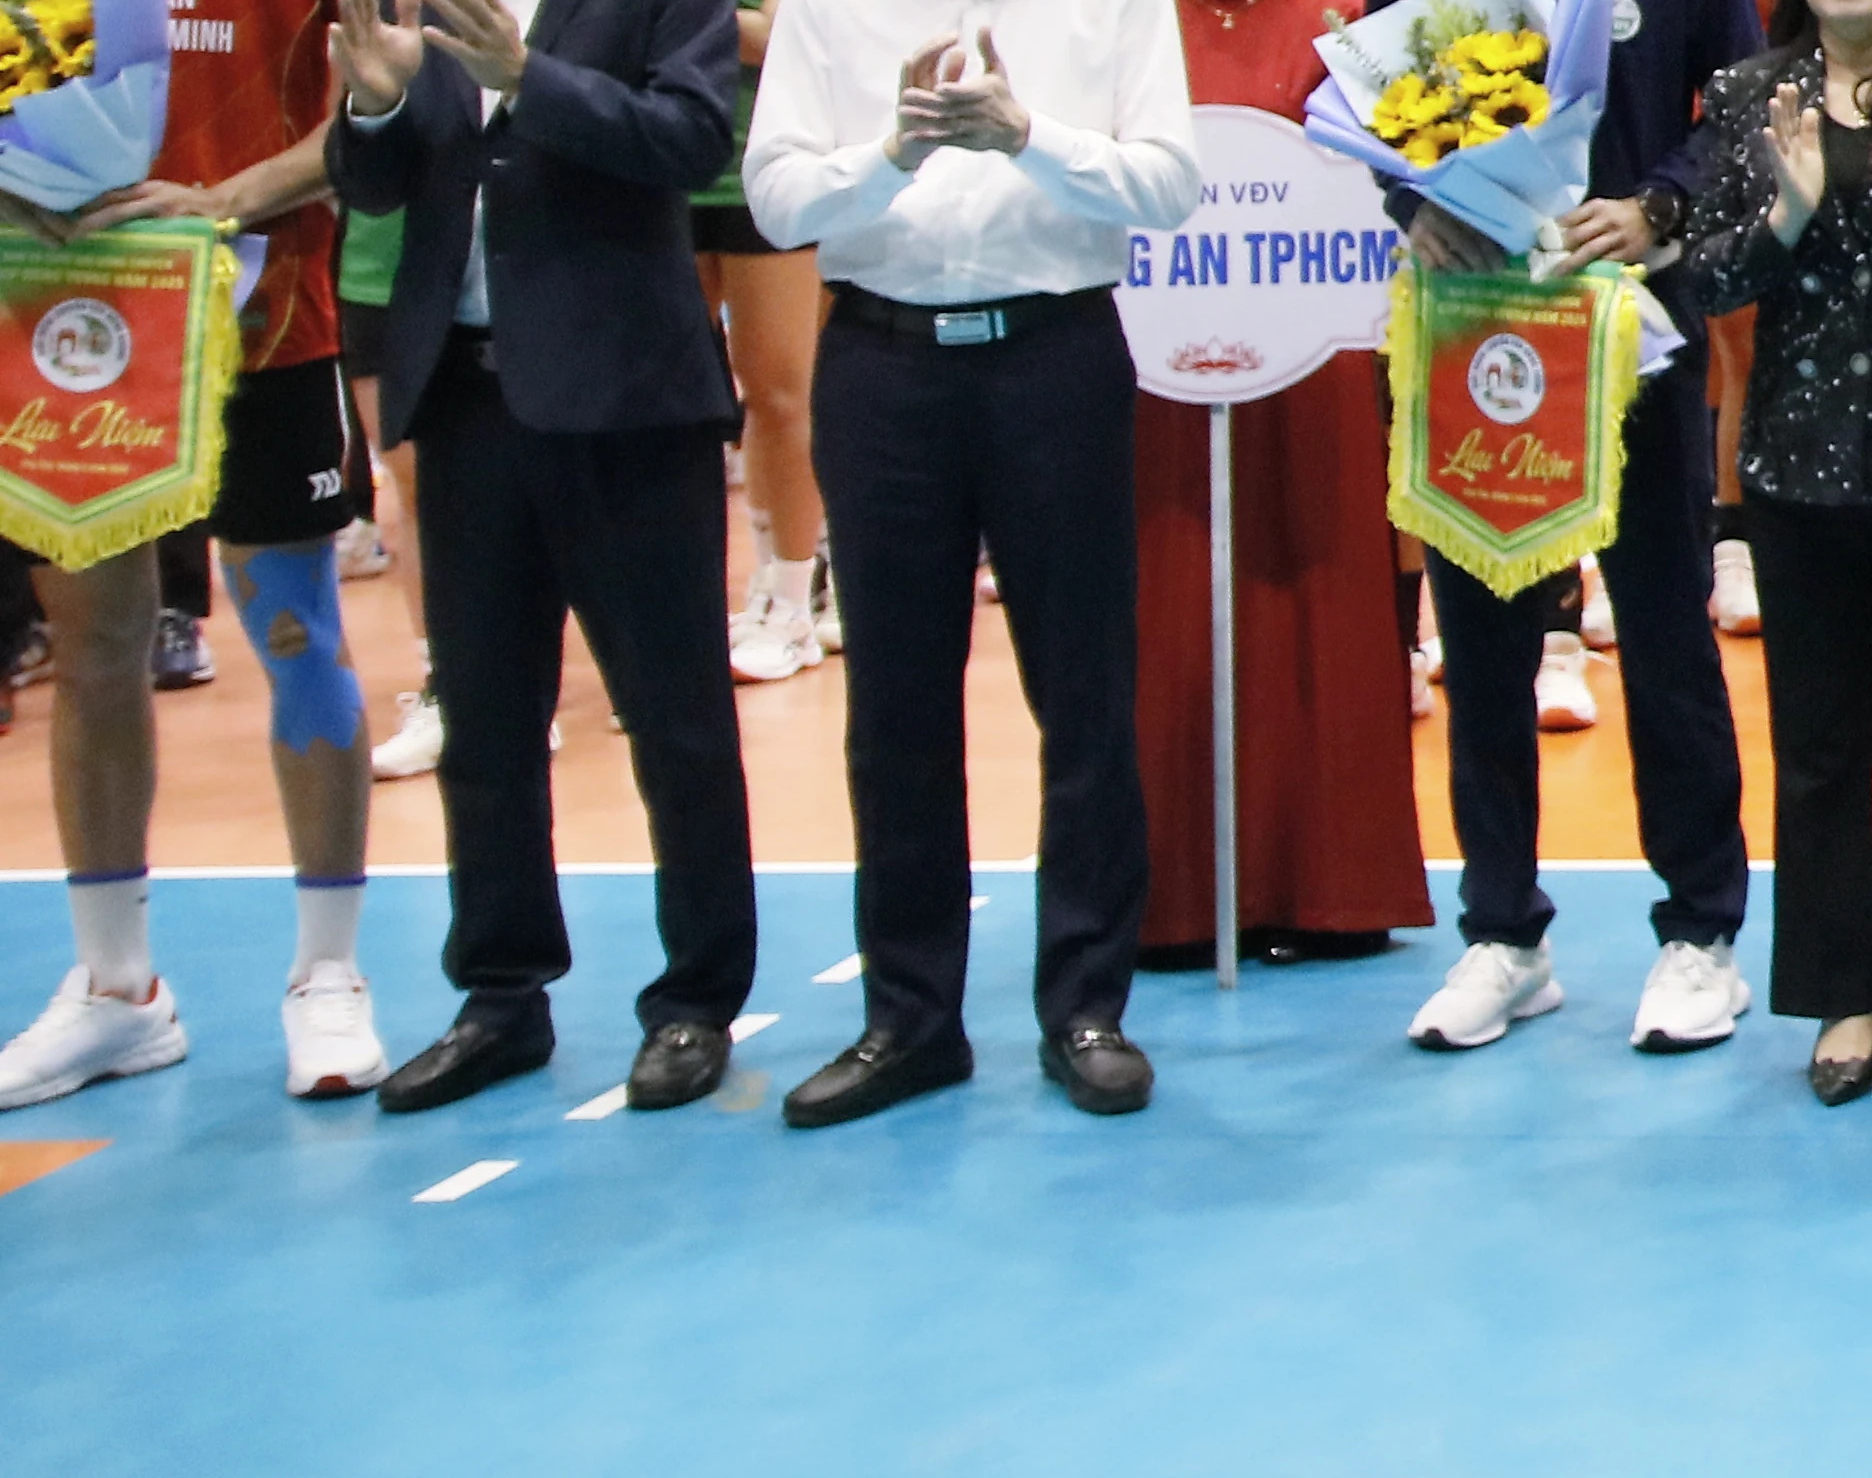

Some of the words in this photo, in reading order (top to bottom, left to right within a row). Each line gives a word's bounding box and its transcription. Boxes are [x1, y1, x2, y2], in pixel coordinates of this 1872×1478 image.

[168, 19, 234, 53] MINH
[1230, 182, 1290, 204] VĐV
[1168, 233, 1229, 287] AN
[1244, 229, 1399, 285] TPHCM
